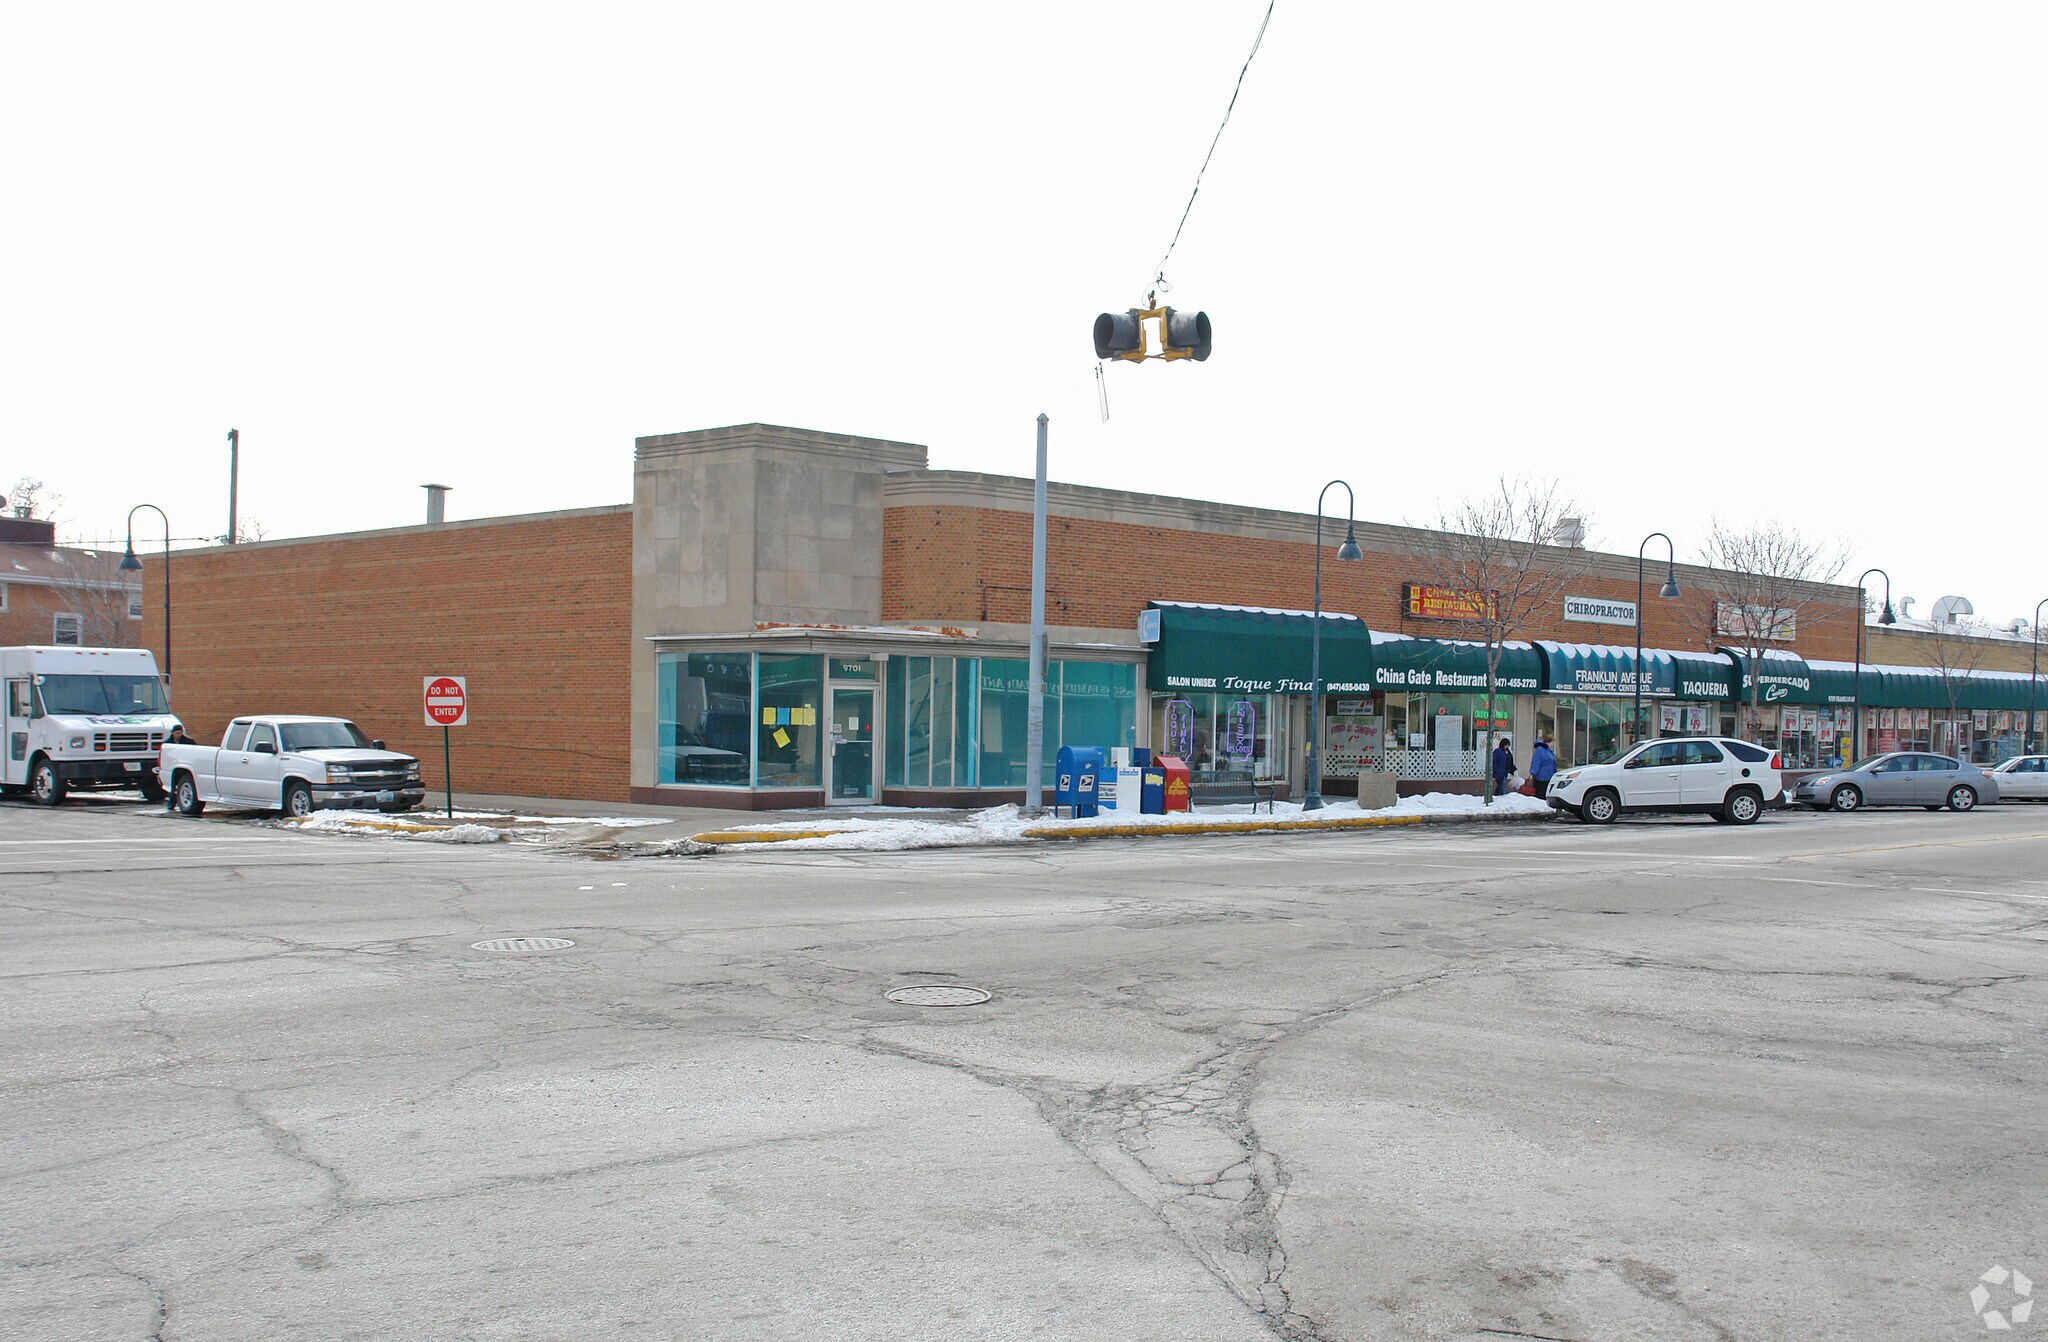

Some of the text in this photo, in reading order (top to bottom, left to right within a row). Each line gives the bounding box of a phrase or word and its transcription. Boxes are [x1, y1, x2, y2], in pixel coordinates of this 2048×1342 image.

[1458, 591, 1481, 602] AE
[1423, 598, 1485, 612] RESTAURANT
[1567, 602, 1635, 620] CHIROPRACTOR
[842, 664, 861, 672] 9701
[1376, 667, 1405, 684] China
[1407, 669, 1432, 686] Gate
[1435, 670, 1487, 688] Restaurant
[1575, 669, 1618, 684] FRANKLIN
[1742, 674, 1810, 692] SUERMERCADO
[430, 686, 459, 695] DO NOT
[1167, 676, 1190, 687] SALON
[1191, 677, 1217, 688] UNISEX
[1223, 675, 1271, 693] Toque
[1275, 678, 1323, 693] Fina
[1577, 683, 1617, 692] CHIROPRACTIC
[1618, 684, 1636, 693] CENTE
[1683, 681, 1729, 697] TAQUERIA
[434, 707, 458, 716] ENTER
[1236, 703, 1246, 746] UNISEX
[1664, 717, 1674, 730] 79
[1690, 718, 1701, 730] 49
